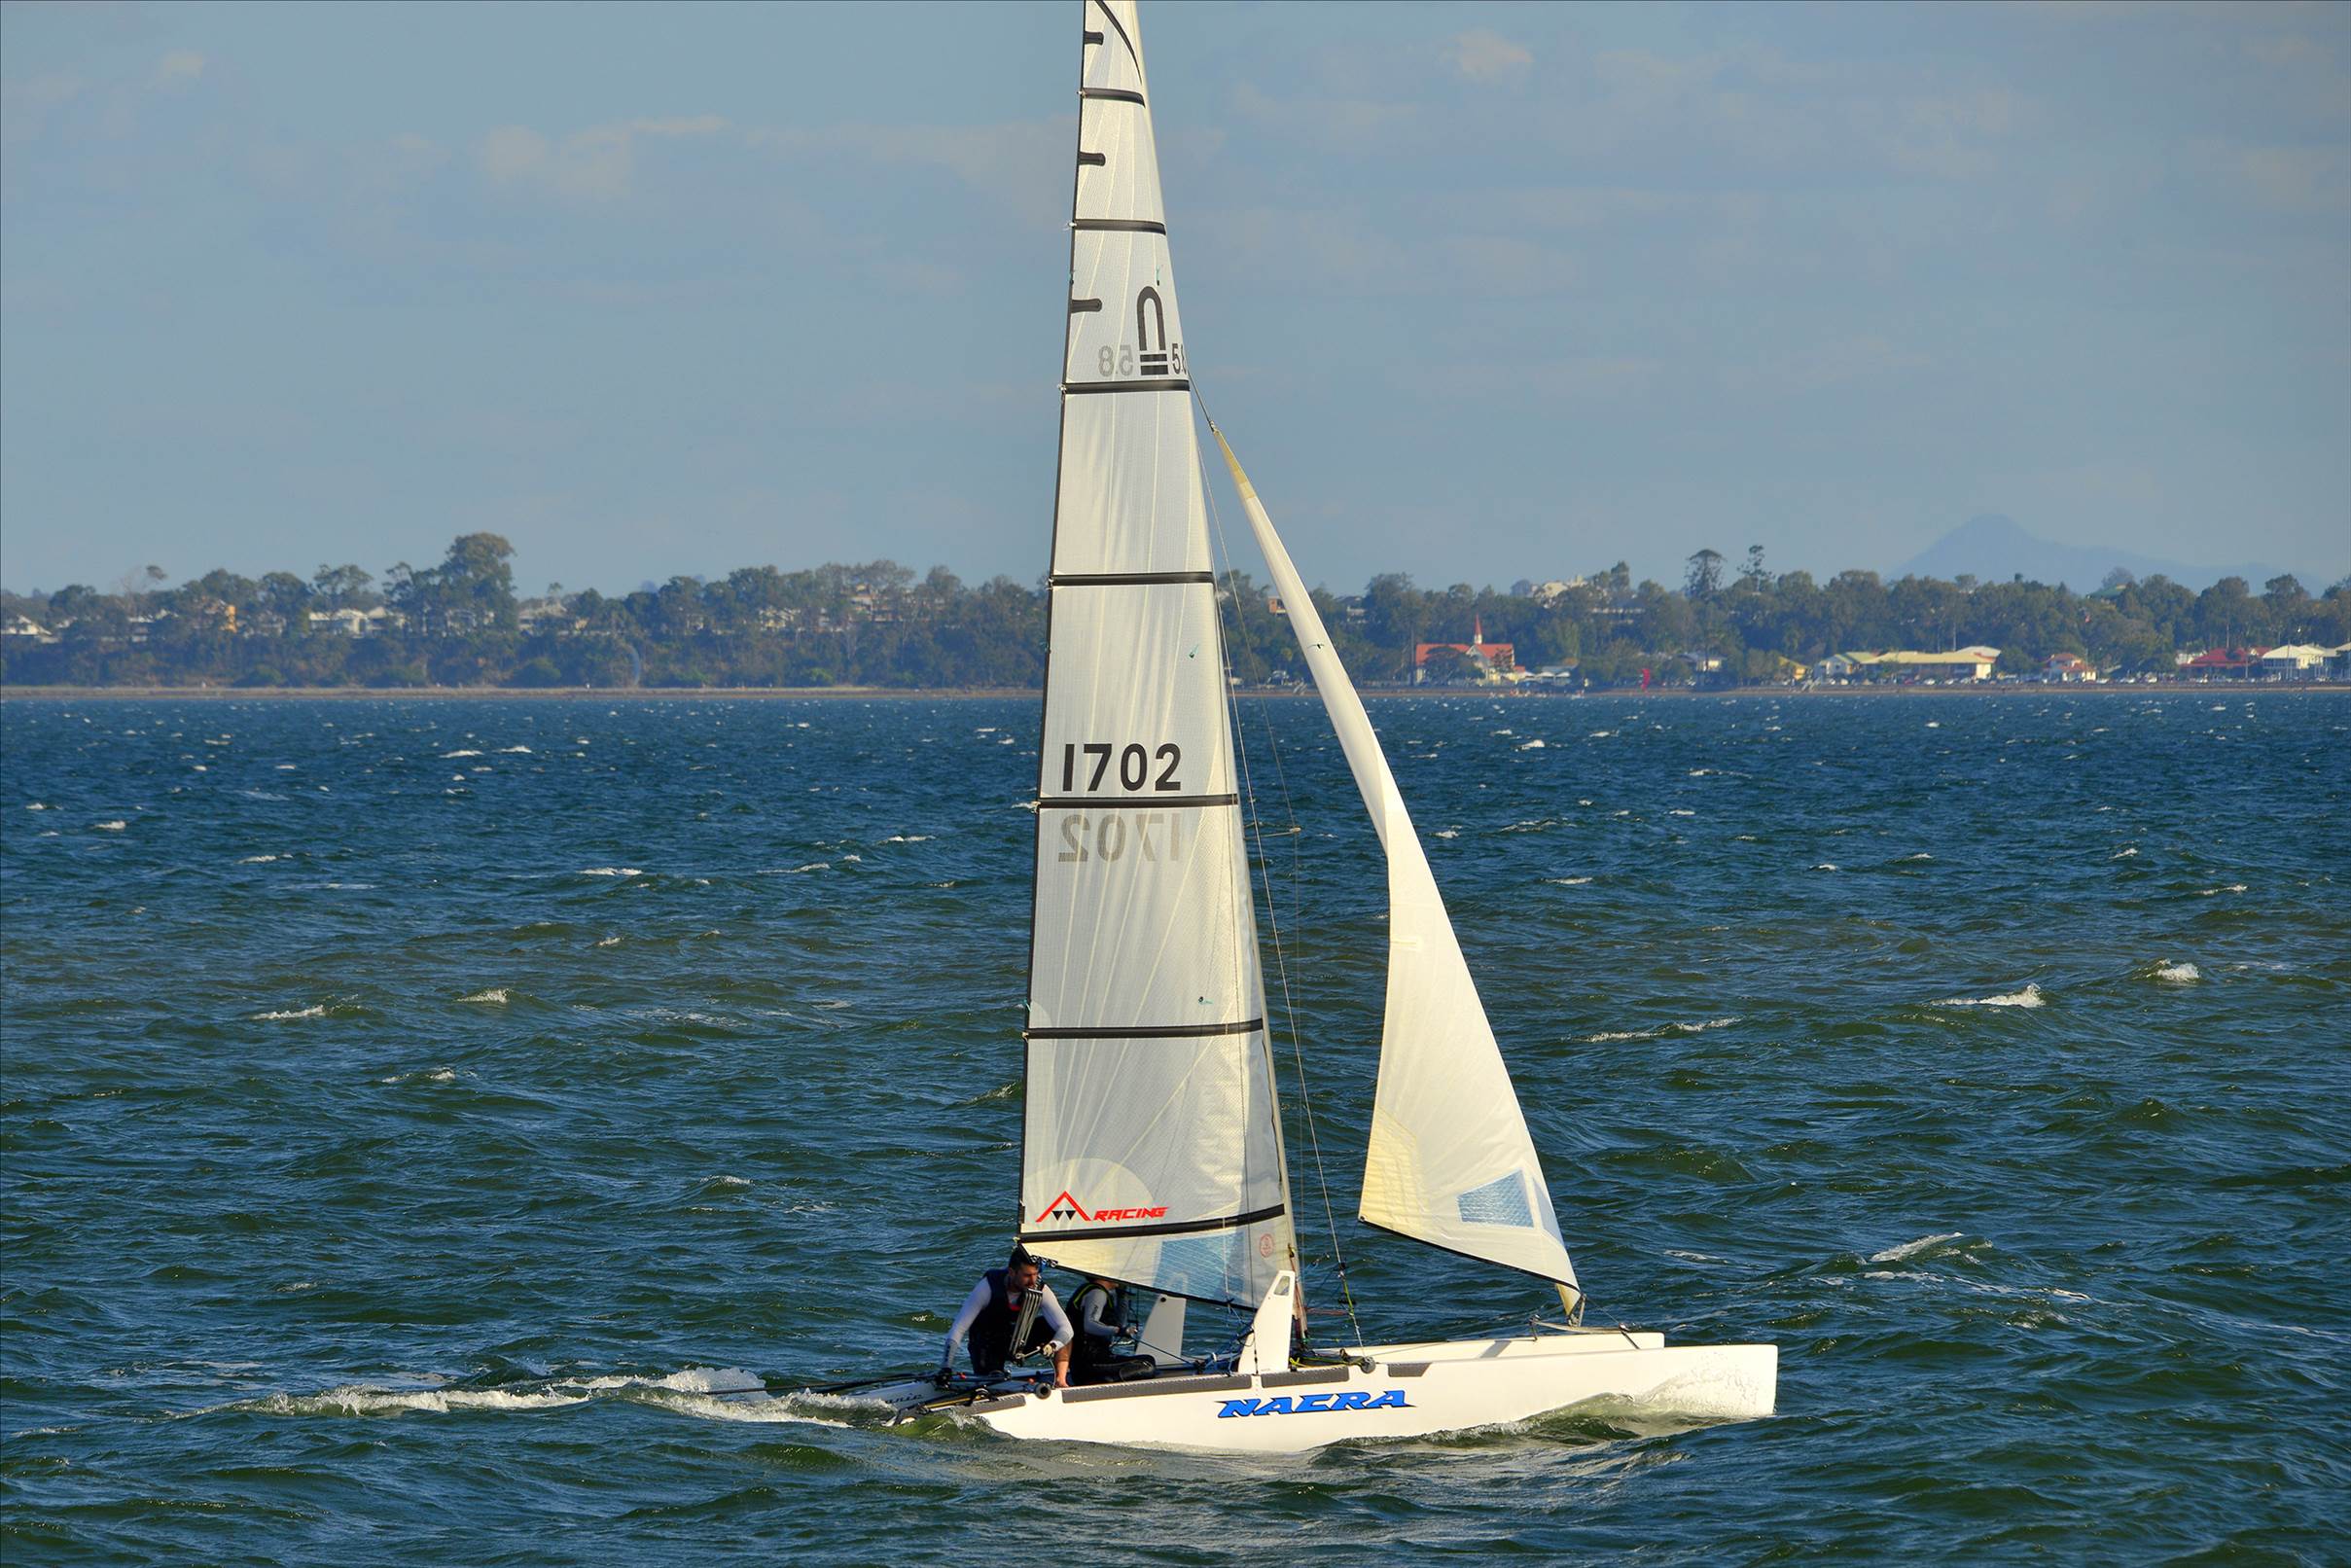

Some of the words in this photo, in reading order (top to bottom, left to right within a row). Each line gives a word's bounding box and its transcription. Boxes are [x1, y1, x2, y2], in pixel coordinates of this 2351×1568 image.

[1062, 743, 1181, 792] 1702
[1093, 1206, 1170, 1223] RACING
[1215, 1390, 1416, 1418] NACRA
